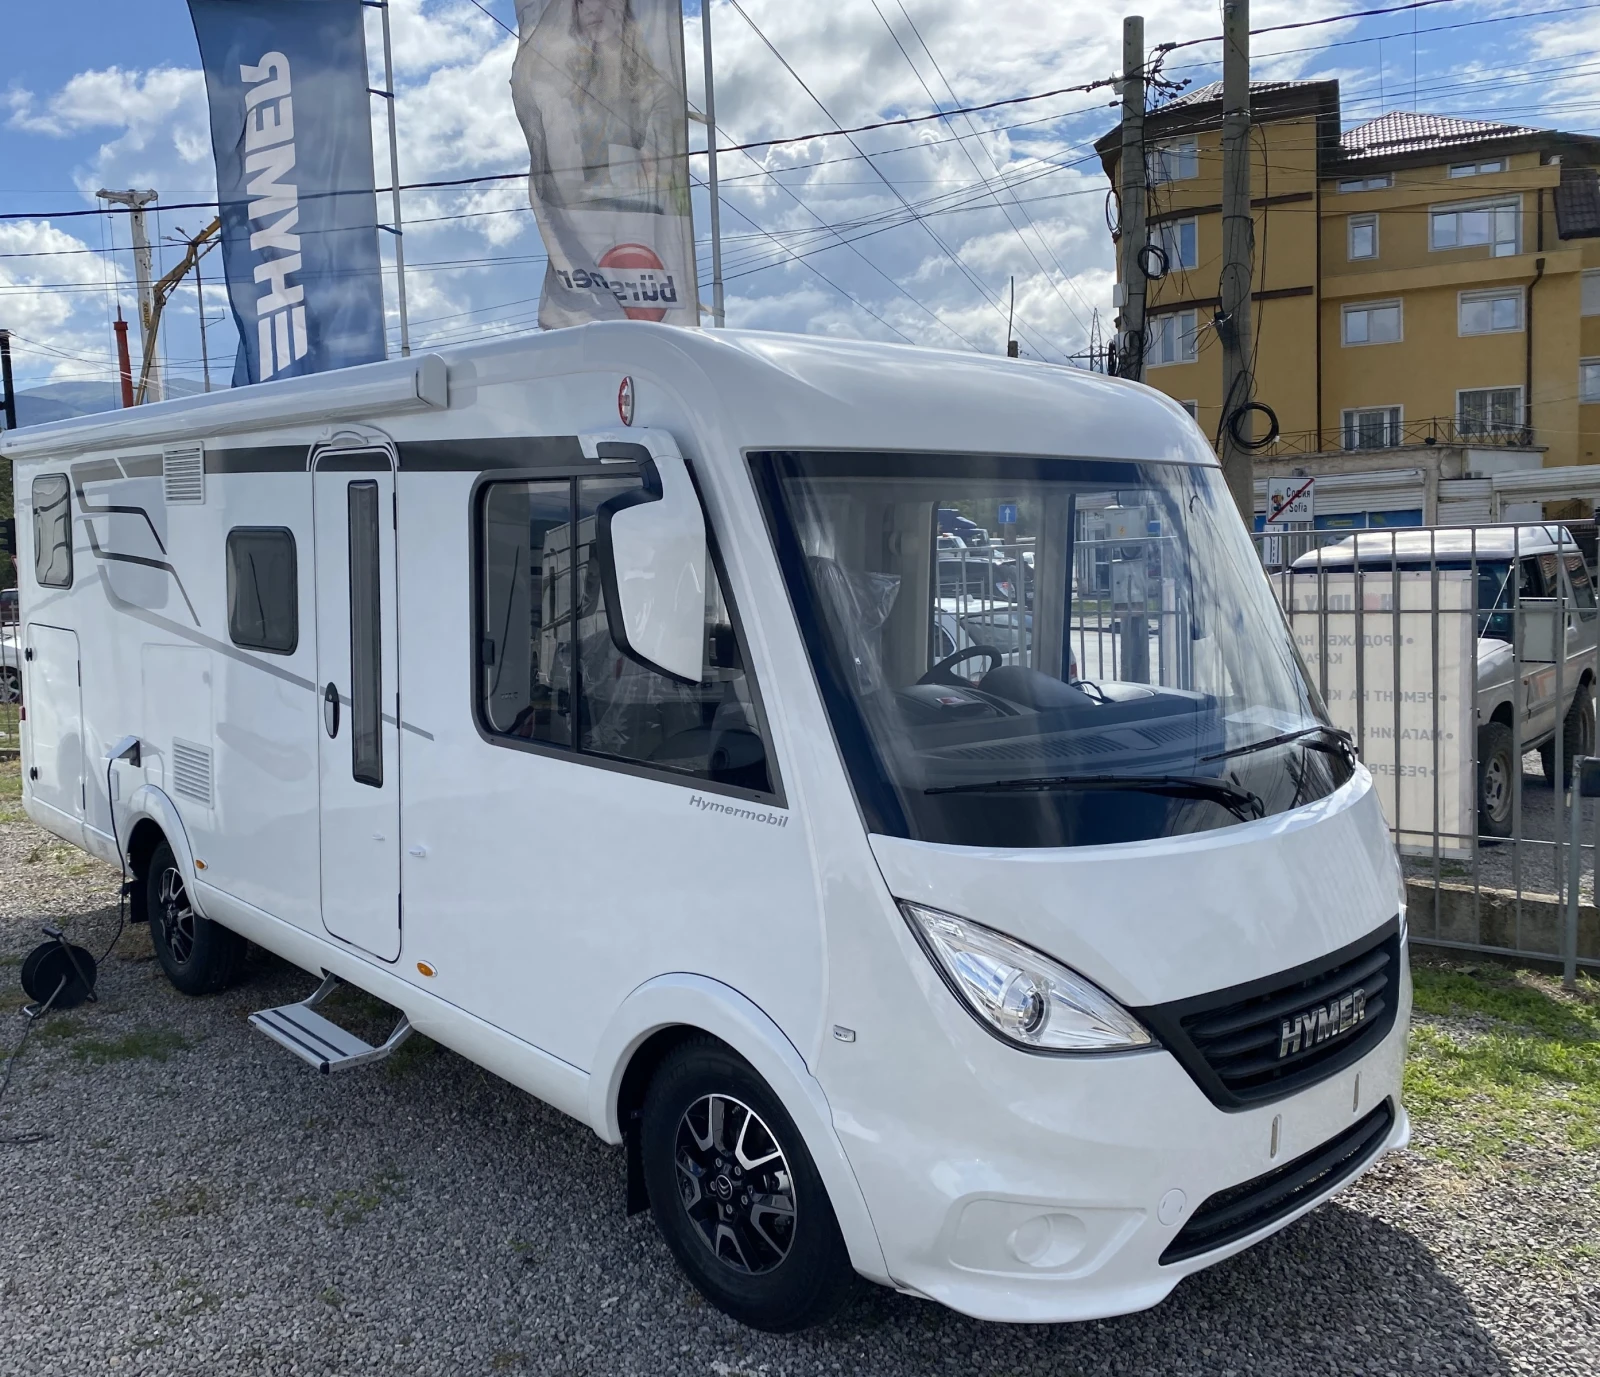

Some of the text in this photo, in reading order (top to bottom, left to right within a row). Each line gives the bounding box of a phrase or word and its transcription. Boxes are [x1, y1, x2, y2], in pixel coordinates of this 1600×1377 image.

[1289, 502, 1308, 513] Sofia
[689, 795, 789, 828] Hymermobil
[1279, 988, 1367, 1058] HYMER
